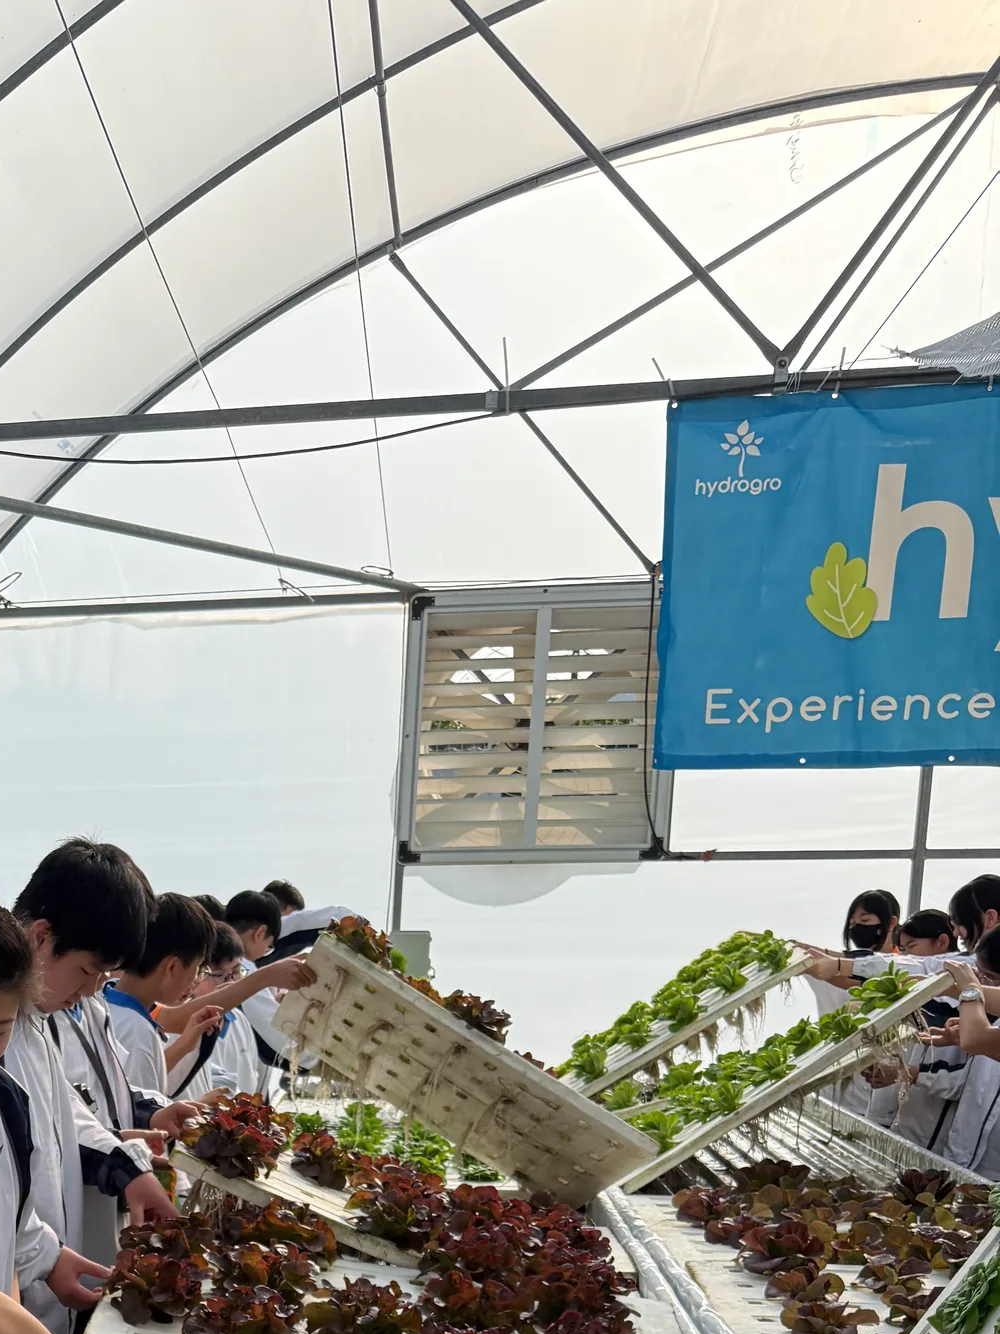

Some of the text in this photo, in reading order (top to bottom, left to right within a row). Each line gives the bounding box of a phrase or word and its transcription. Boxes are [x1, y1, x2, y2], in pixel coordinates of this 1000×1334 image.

[695, 476, 782, 498] hydrogro
[865, 463, 1000, 652] h
[705, 688, 996, 733] Experience
